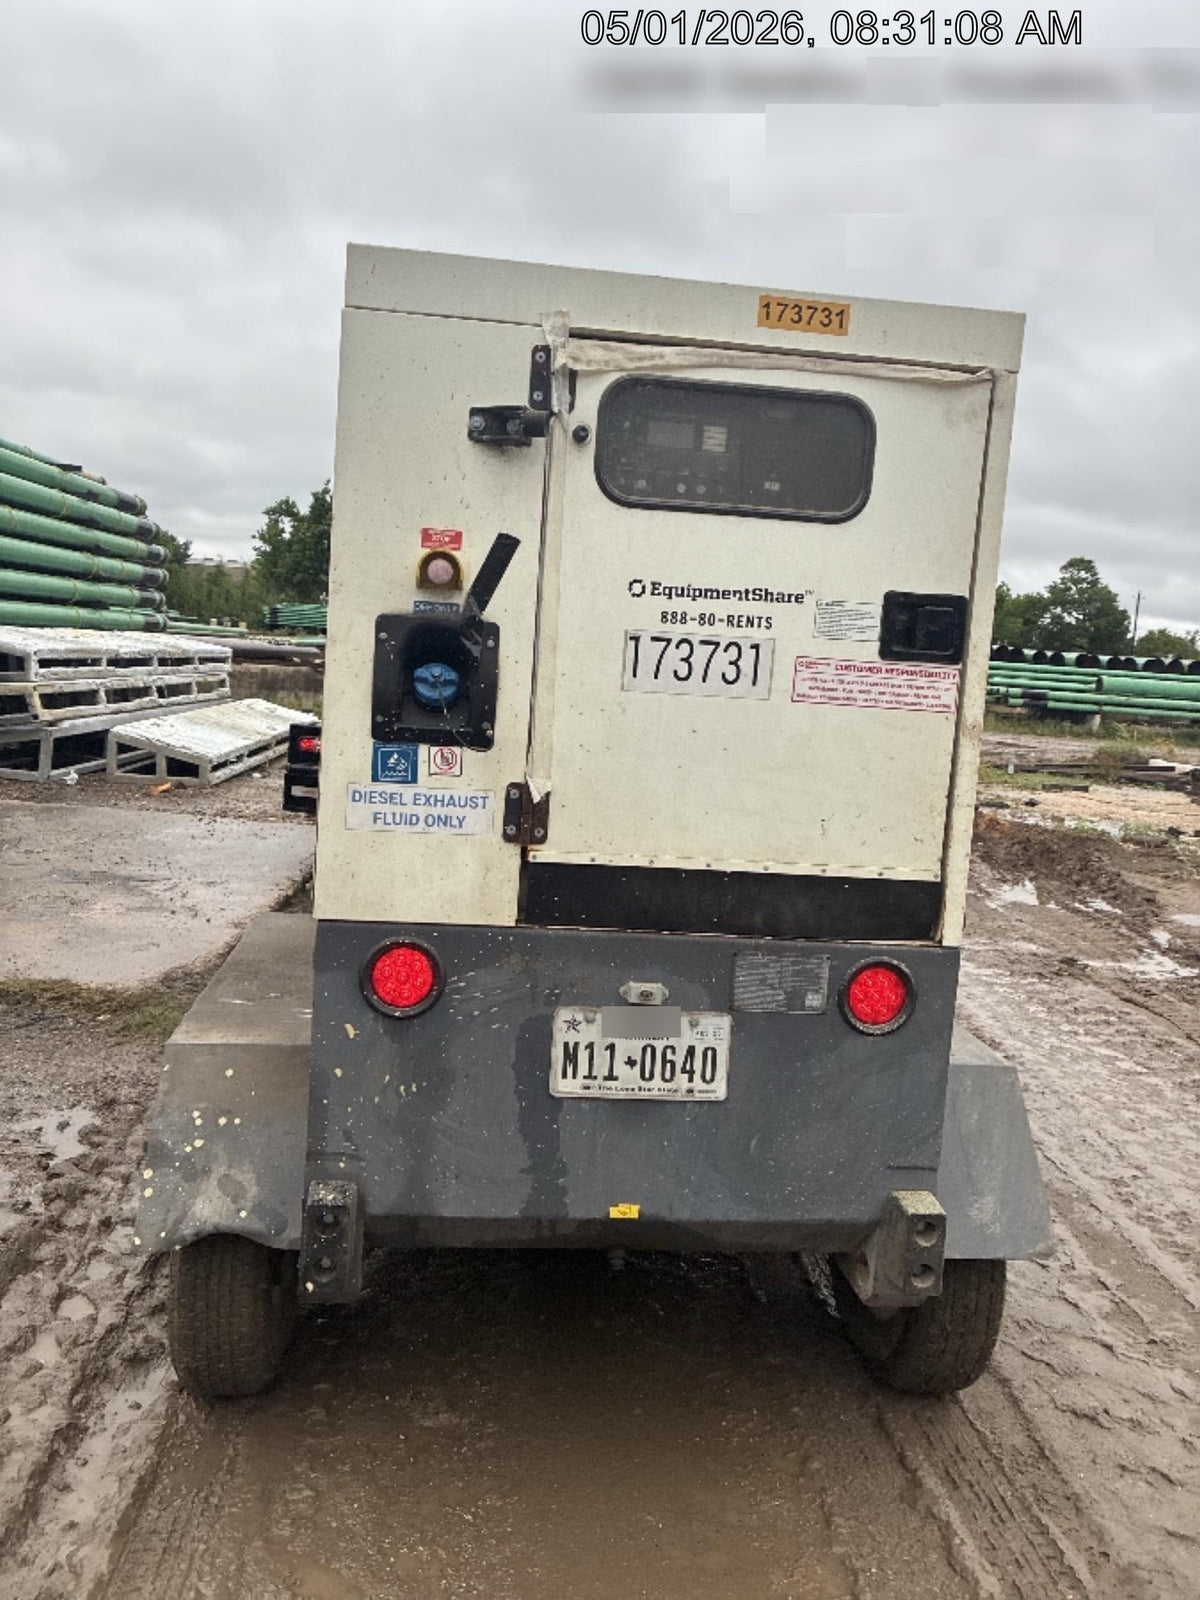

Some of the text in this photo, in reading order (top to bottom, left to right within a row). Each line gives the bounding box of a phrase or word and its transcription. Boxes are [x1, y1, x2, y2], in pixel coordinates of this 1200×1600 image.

[761, 300, 846, 330] 173731
[660, 610, 774, 630] 888-80-RENTS
[628, 635, 761, 687] 173731
[351, 789, 490, 810] DIESEL EXHAUST
[372, 811, 467, 829] FLUID ONLY
